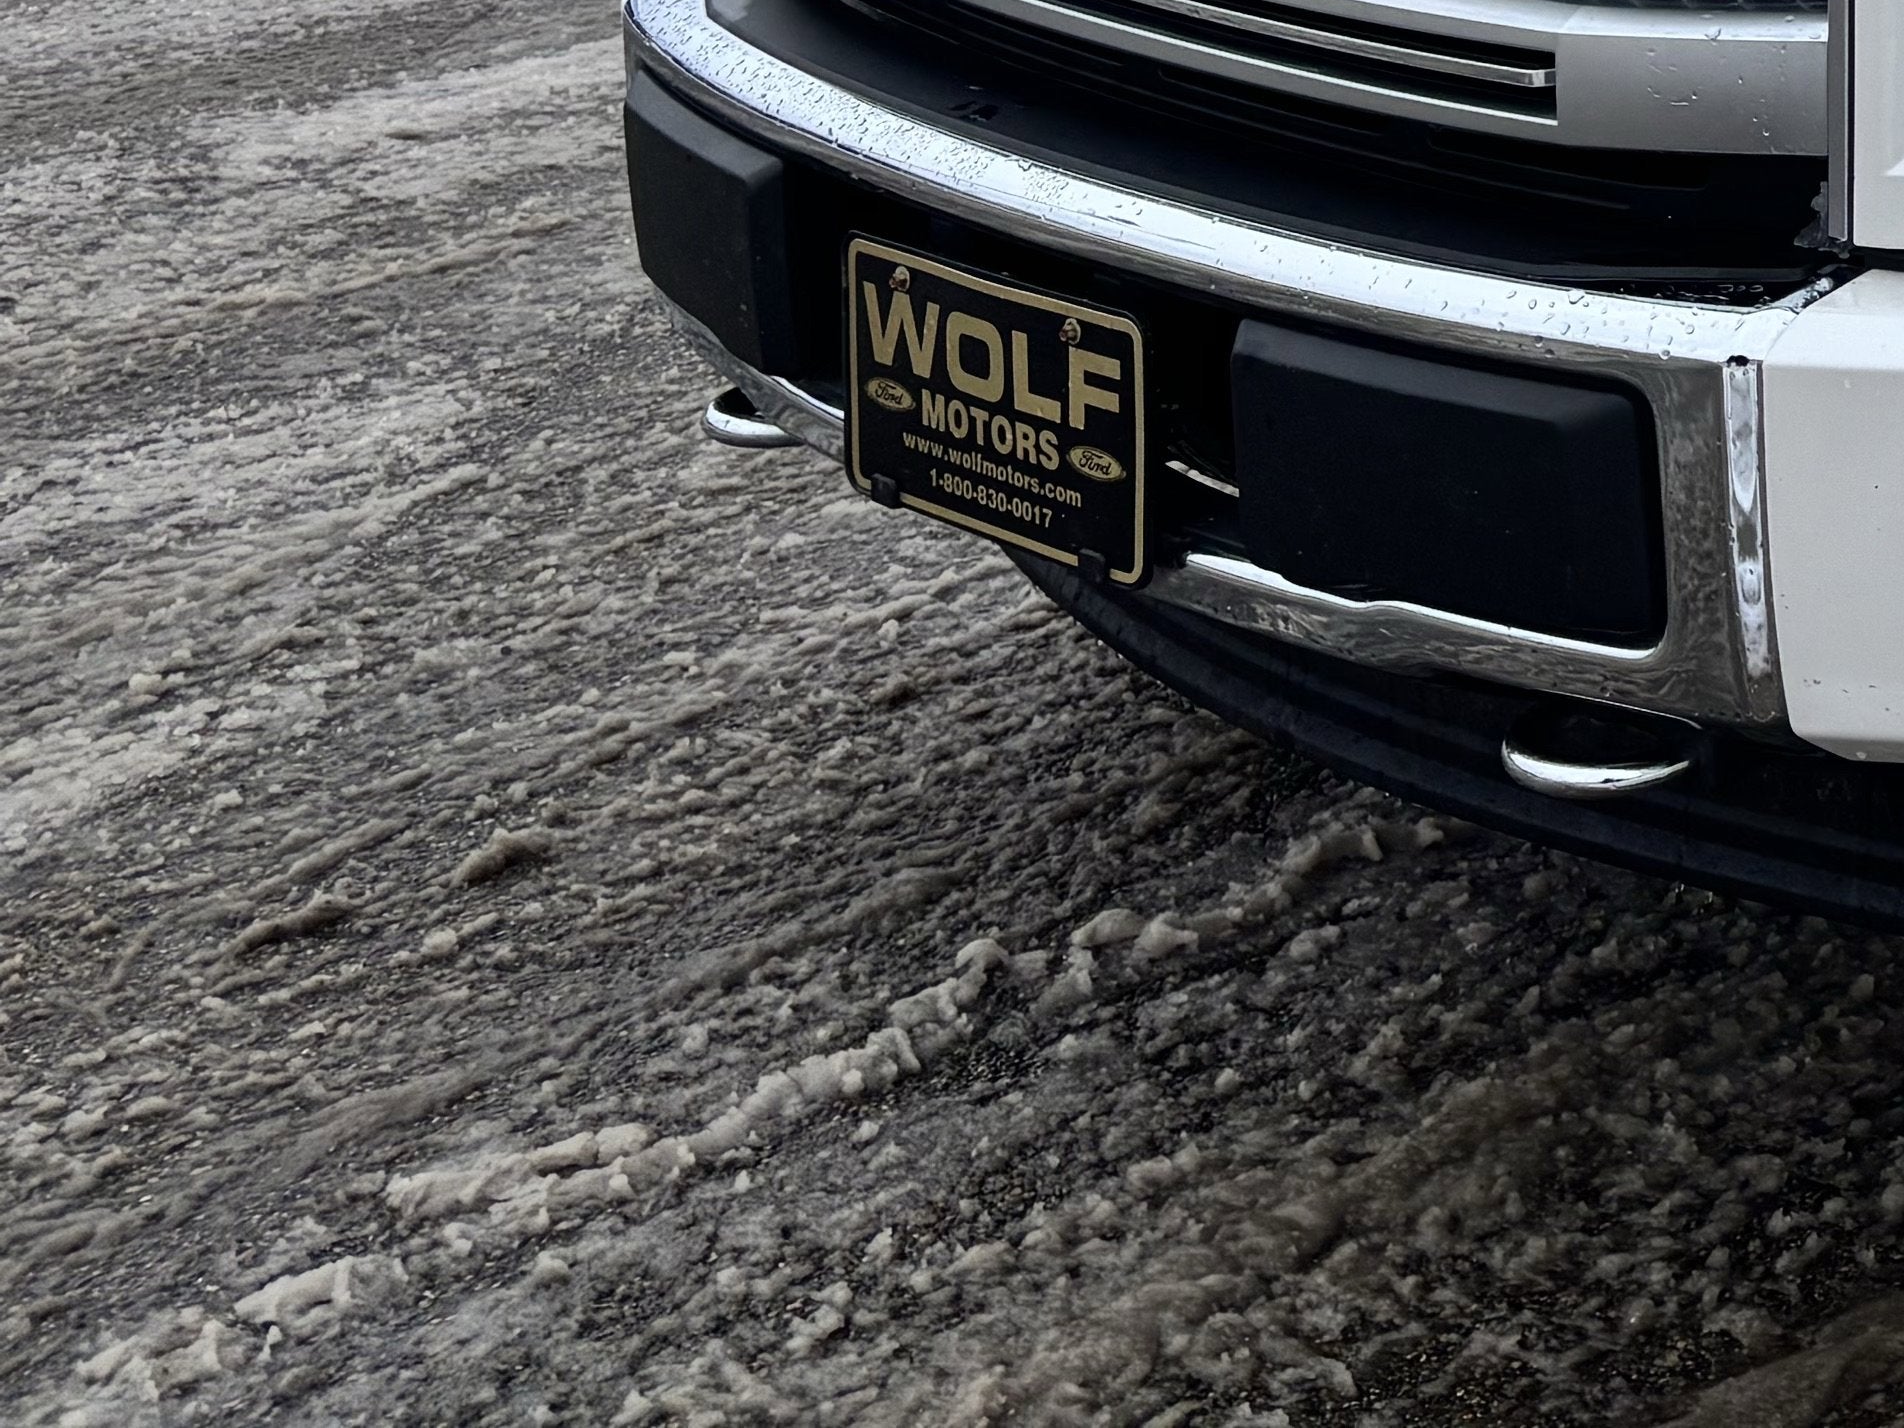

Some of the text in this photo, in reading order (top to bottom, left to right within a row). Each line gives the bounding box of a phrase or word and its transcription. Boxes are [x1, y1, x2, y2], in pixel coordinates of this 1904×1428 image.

[862, 280, 1121, 430] WOLF
[873, 379, 908, 407] Ford
[921, 388, 1060, 471] MOTORS
[1078, 449, 1113, 477] Ford
[902, 431, 1082, 508] www.wolfmotors.com
